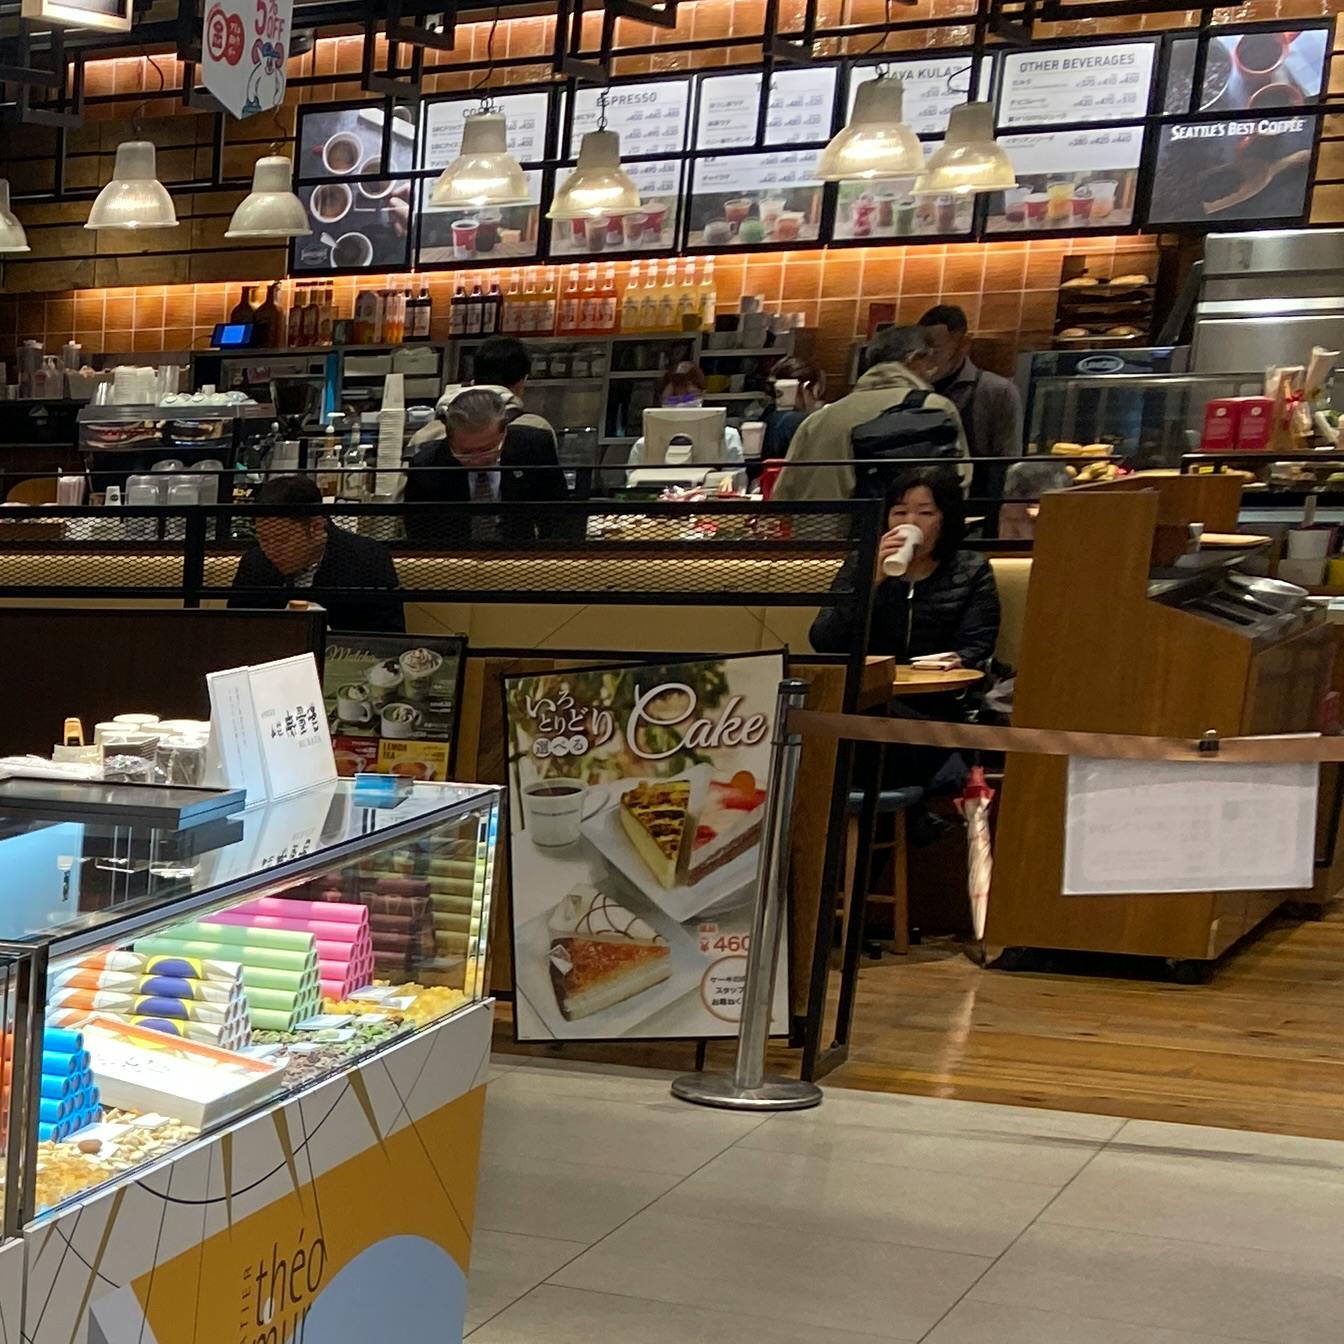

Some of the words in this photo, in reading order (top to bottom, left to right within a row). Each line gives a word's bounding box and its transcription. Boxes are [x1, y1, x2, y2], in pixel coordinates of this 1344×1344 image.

[1020, 59, 1059, 73] OTHER
[1063, 53, 1135, 70] BEVERAGES
[597, 91, 657, 107] ESPRESSO
[1170, 123, 1226, 141] SEATTLE'S
[1227, 121, 1256, 136] BEST
[626, 682, 768, 760] Cake
[256, 1228, 324, 1326] théo
